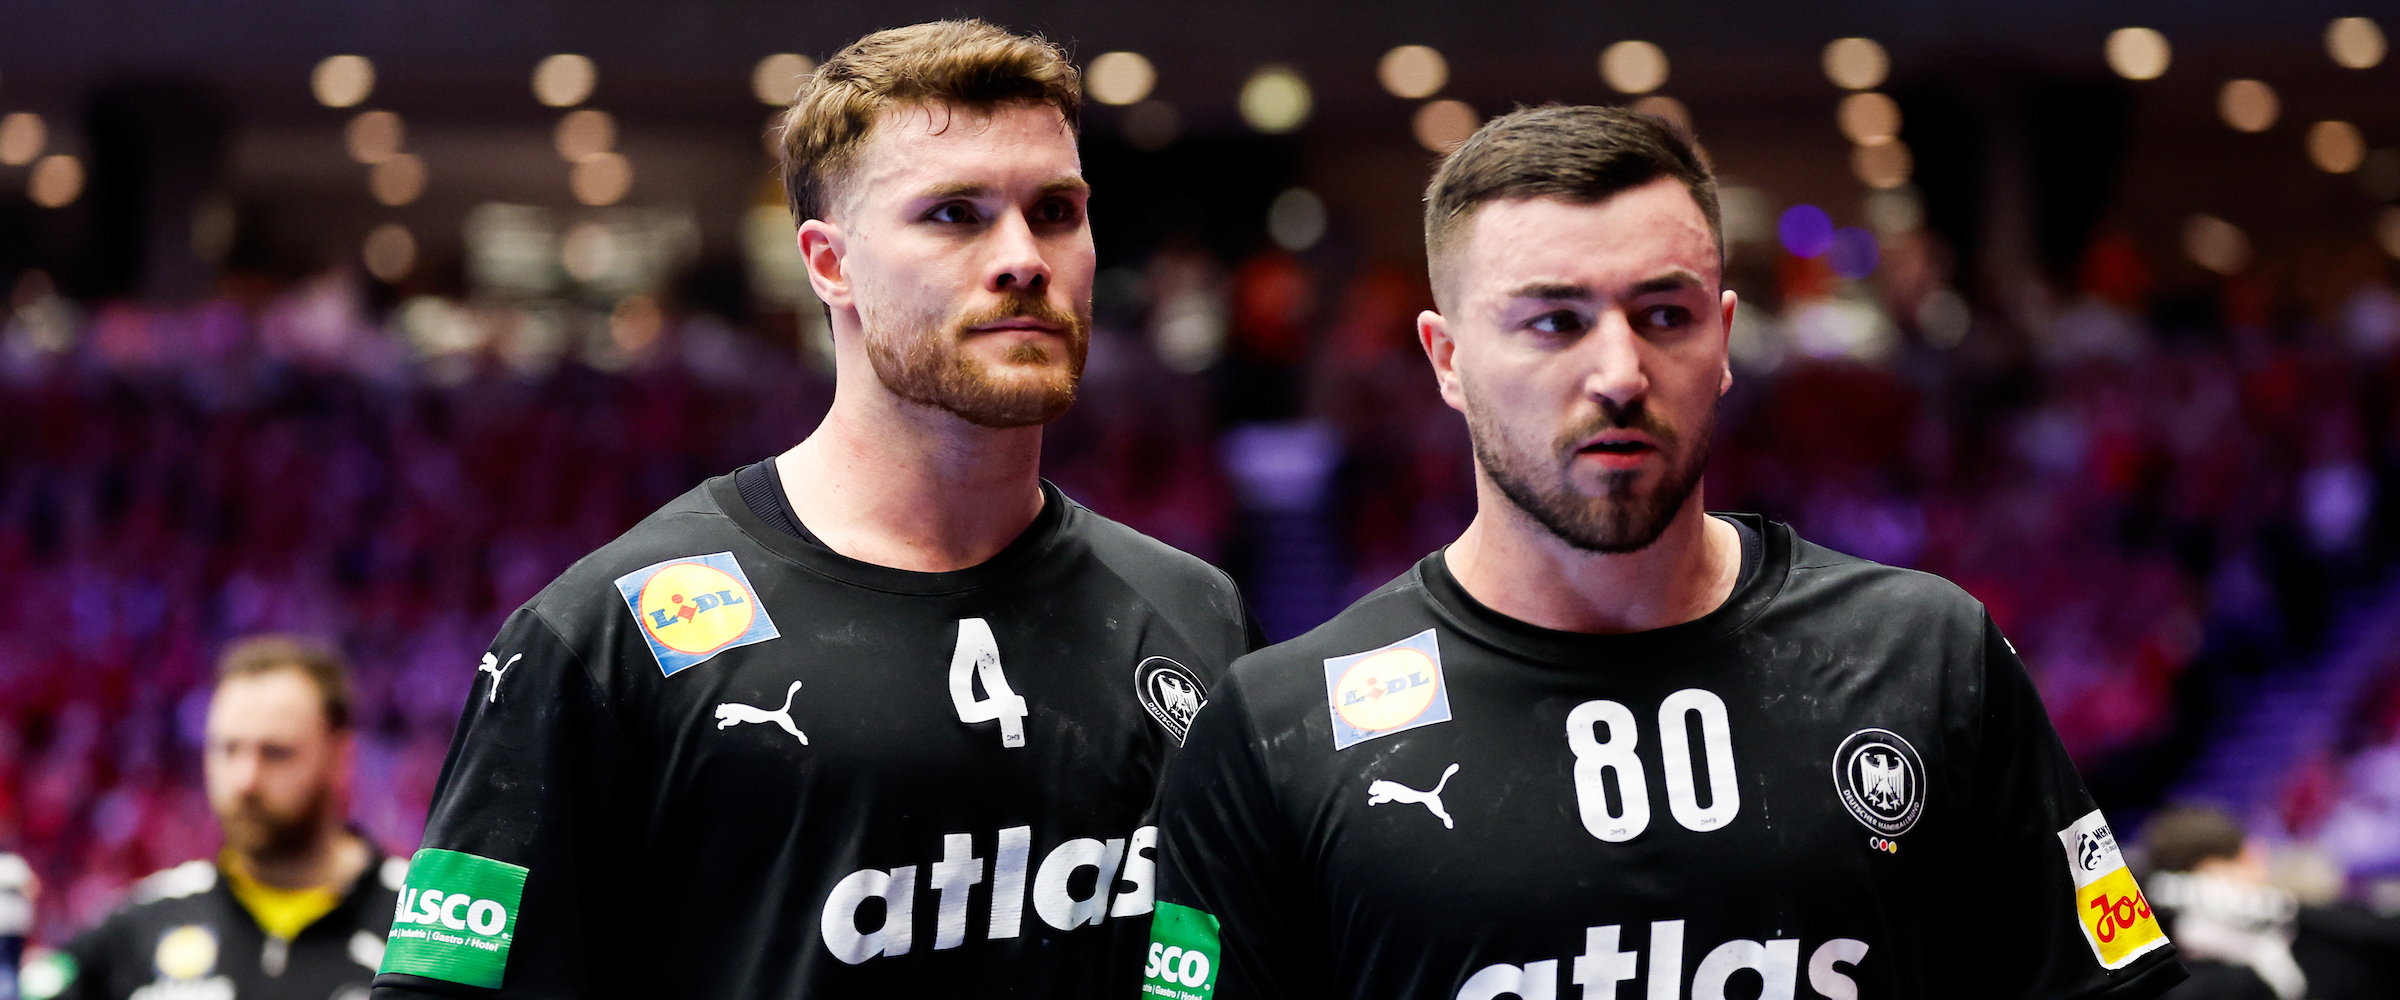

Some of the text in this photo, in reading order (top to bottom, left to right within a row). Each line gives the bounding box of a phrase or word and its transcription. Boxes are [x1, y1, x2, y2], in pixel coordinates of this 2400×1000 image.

[949, 617, 1028, 748] 4
[1566, 688, 1741, 843] 80
[1843, 788, 1878, 826] DEUTSCHER
[432, 931, 464, 945] Gastro
[471, 939, 499, 952] Hotel
[820, 825, 1158, 965] atlas
